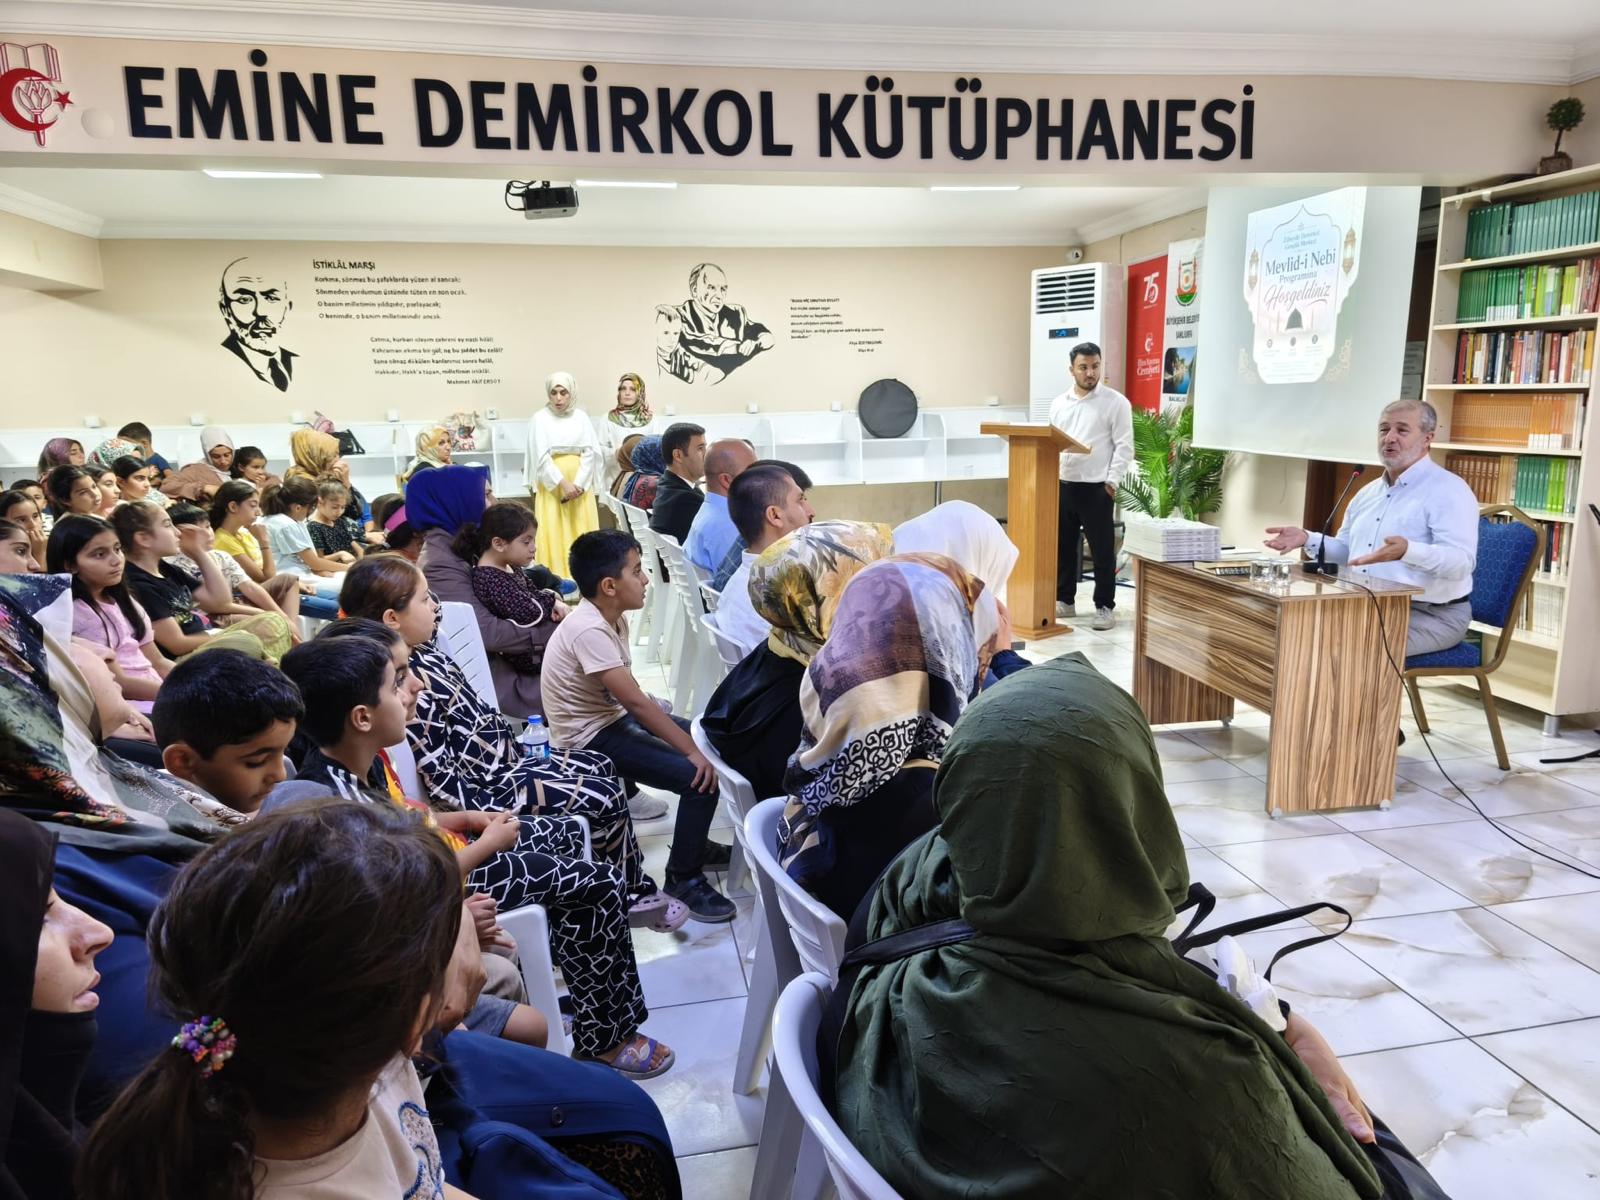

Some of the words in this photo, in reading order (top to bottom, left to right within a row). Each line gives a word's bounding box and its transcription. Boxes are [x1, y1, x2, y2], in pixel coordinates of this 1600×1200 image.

[123, 49, 384, 145] EMİNE
[413, 65, 793, 157] DEMİRKOL
[818, 75, 1255, 162] KÜTÜPHANESİ
[312, 259, 347, 269] İSTİKLÂL
[348, 261, 376, 270] MARŞI
[1266, 254, 1308, 276] Mevlid-i
[1311, 248, 1336, 268] Nebi
[1144, 272, 1160, 304] 75
